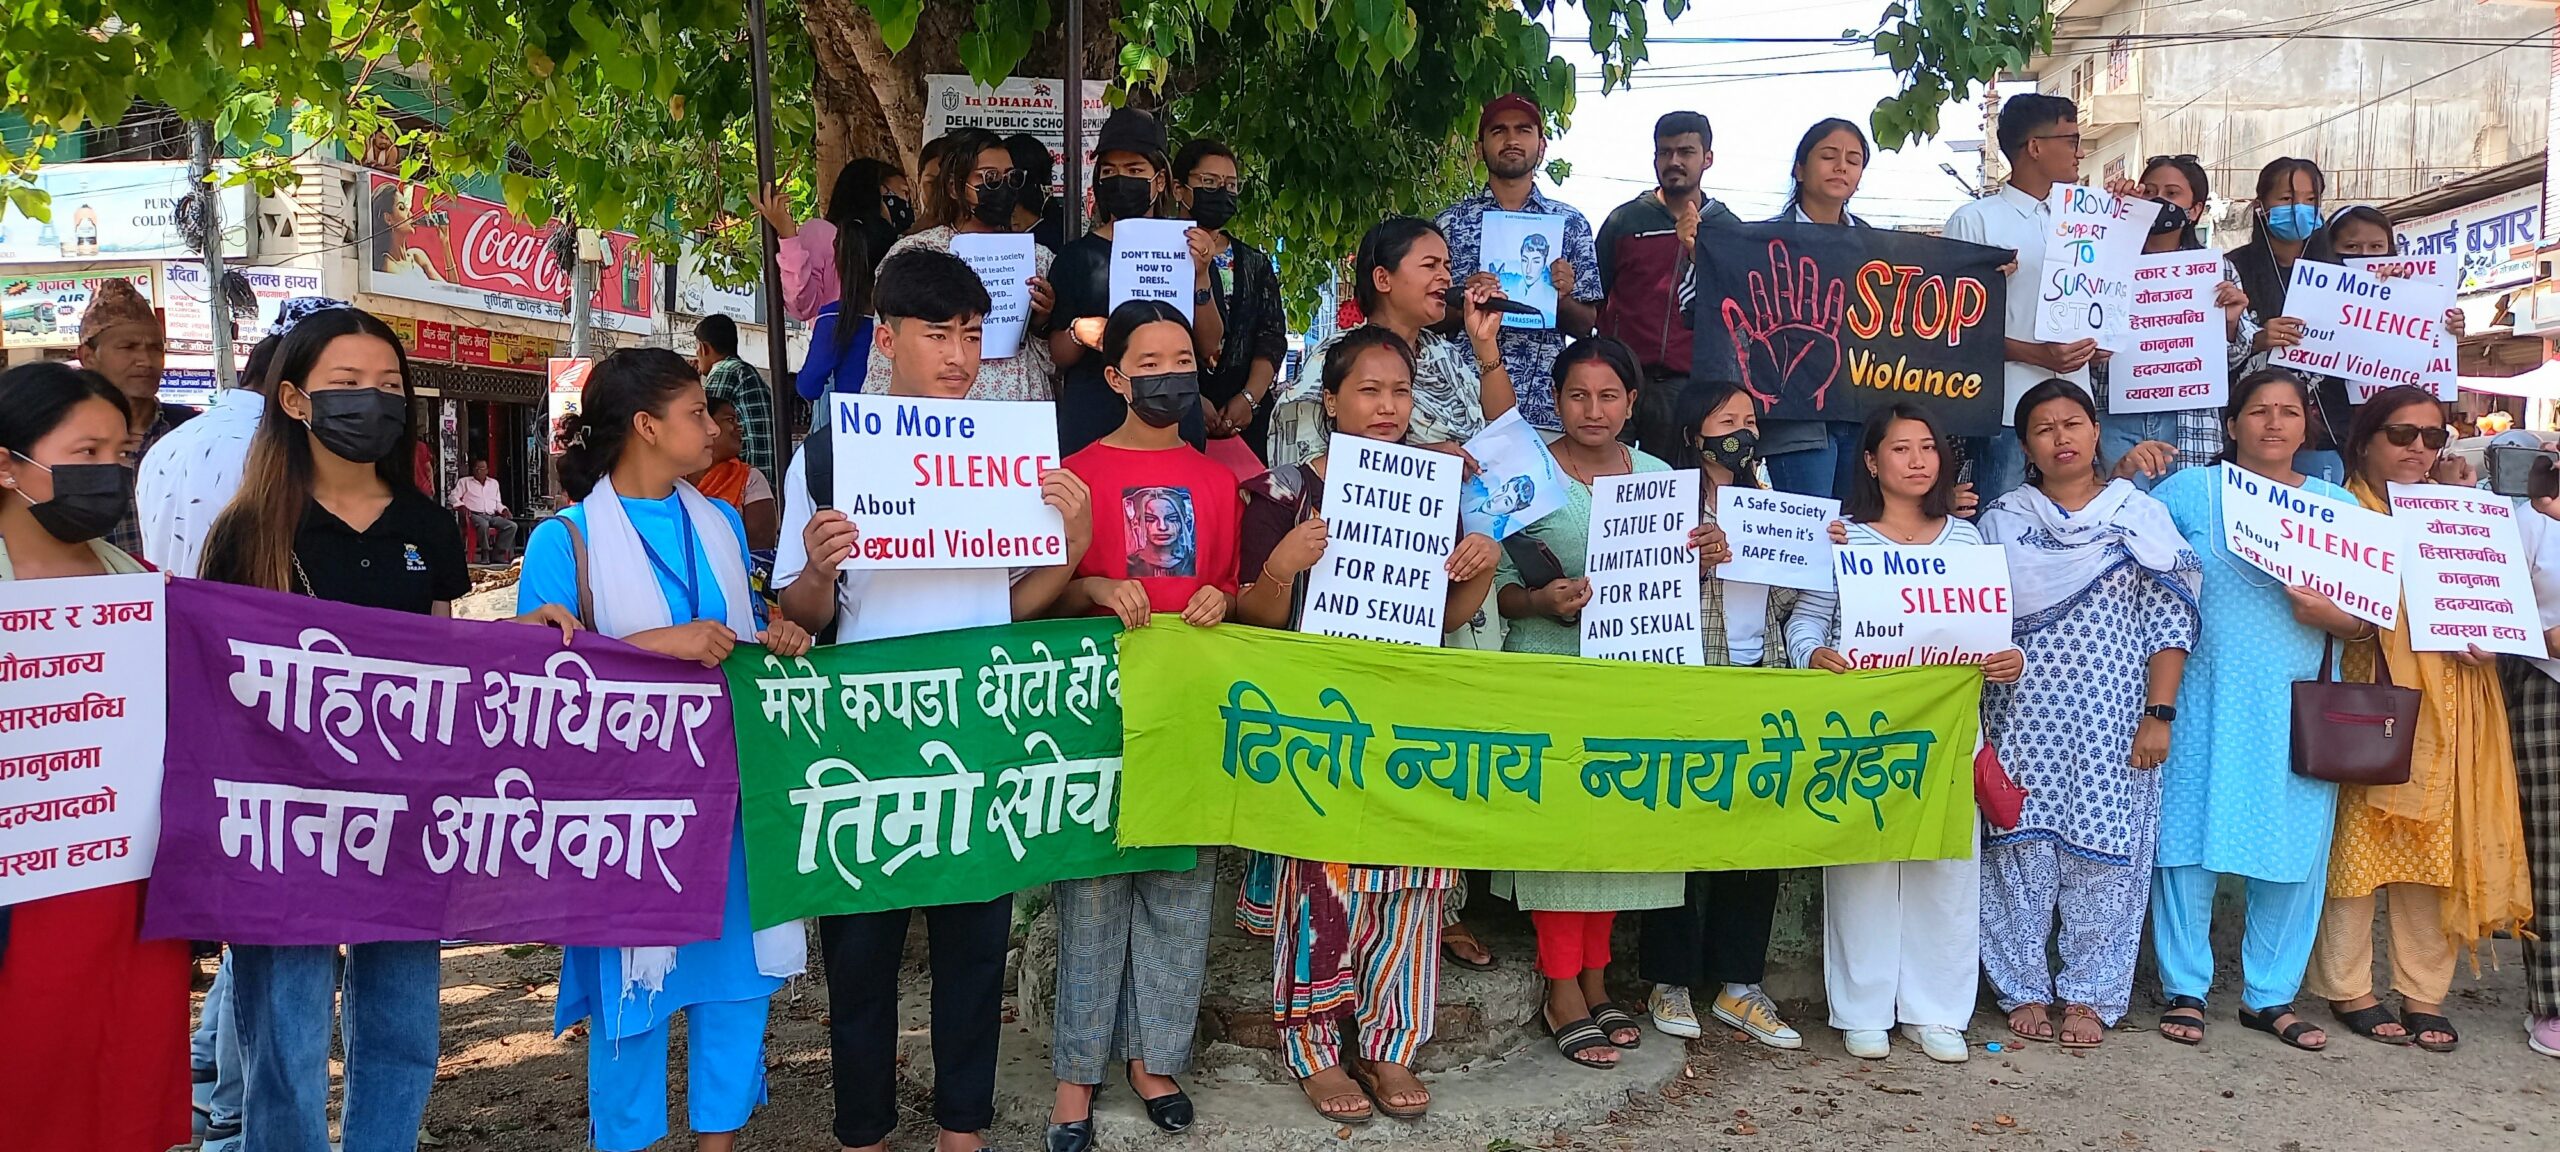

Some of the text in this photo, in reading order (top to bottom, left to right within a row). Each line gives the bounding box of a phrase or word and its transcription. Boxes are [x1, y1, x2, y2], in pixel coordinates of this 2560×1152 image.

[965, 96, 981, 106] In
[946, 115, 982, 127] DELHI
[987, 117, 1029, 127] PUBLIC
[1032, 118, 1063, 128] SCHO
[145, 198, 183, 209] PURN
[2064, 189, 2133, 220] PROVIDE
[132, 216, 165, 227] COLD
[2467, 205, 2538, 252] बजार
[1121, 251, 1186, 260] DON'T TELL ME
[2064, 239, 2095, 267] TO
[1136, 263, 1173, 273] HOW TO
[2134, 262, 2217, 281] त्कार र अन्य
[1131, 289, 1177, 299] TELL THEM
[2044, 268, 2127, 301] SURVIVRS
[2136, 288, 2193, 304] यौनजन्य
[2297, 265, 2392, 301] No More
[57, 294, 84, 303] AIR
[1009, 302, 1016, 310] of
[1846, 260, 1987, 347] STOP
[1508, 315, 1542, 324] HARASSMEN
[2339, 304, 2434, 342] SILENCE
[2140, 337, 2194, 353] कानुनमा
[1848, 347, 1982, 399] Violance
[2133, 357, 2202, 377] हदम्यादको
[2278, 346, 2341, 370] Sexual
[2346, 354, 2420, 385] Violence
[2126, 383, 2211, 400] व्यवस्था हटाउ
[840, 402, 975, 439] No More
[913, 454, 1051, 487] SILENCE
[1359, 448, 1437, 482] REMOVE
[853, 494, 916, 515] About
[1341, 482, 1444, 519] STATUE OF
[1616, 479, 1677, 503] REMOVE
[2228, 467, 2335, 523] No More
[1734, 496, 1827, 521] A Safe Society
[2394, 496, 2509, 518] बलात्कार र अन्य
[1327, 517, 1450, 556] LIMITATIONS
[1603, 512, 1685, 538] STATUE OF
[1743, 520, 1814, 541] is when it's
[2235, 520, 2279, 552] About
[2426, 519, 2490, 538] यौनजन्य
[944, 528, 1060, 558] Violence
[1742, 545, 1808, 566] RAPE free.
[2280, 518, 2395, 574] SILENCE
[1590, 545, 1695, 573] LIMITATIONS
[1840, 551, 1946, 575] No More
[1334, 556, 1431, 591] FOR RAPE
[2233, 535, 2393, 621] Sexual Violence
[2438, 572, 2500, 589] कानुनमा
[1600, 579, 1682, 605] FOR RAPE
[1901, 587, 2008, 614] SILENCE
[2434, 597, 2514, 614] हदम्यादको
[65, 605, 84, 629] र
[92, 601, 154, 626] अन्य
[1313, 591, 1436, 628] AND SEXUAL
[1588, 612, 1695, 640] AND SEXUAL
[1855, 621, 1904, 638] About
[2430, 624, 2527, 641] व्यवस्था हटाउ
[1848, 645, 1994, 670] Sexual Violen
[228, 627, 724, 767] महिला अधिकार
[756, 654, 832, 748] मेरो
[839, 667, 964, 733] कपडा
[0, 692, 126, 733] सासम्बन्धि
[1218, 680, 1937, 831] ढिलो न्याय न्याय नै होईन
[0, 785, 117, 830] दम्यादको
[788, 740, 985, 891] तिम्रो
[213, 767, 698, 893] मानव अधिकार
[66, 836, 131, 867] हटाउ
